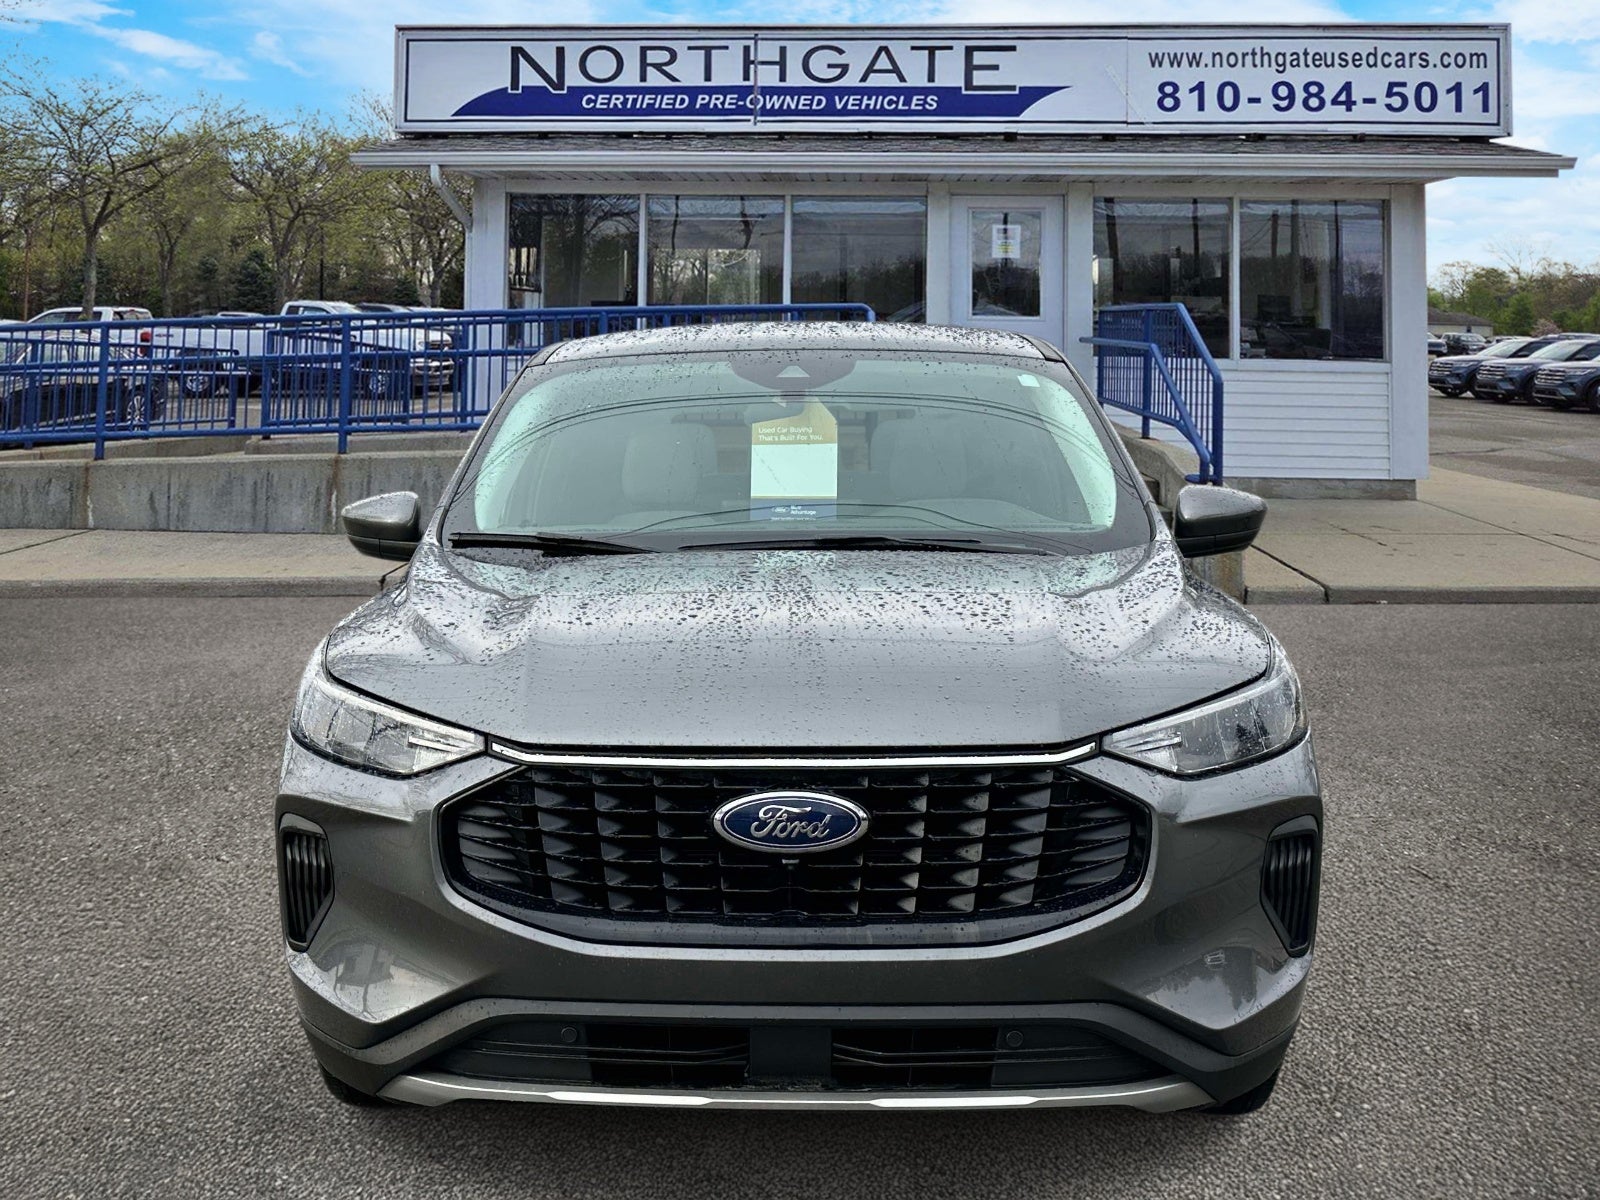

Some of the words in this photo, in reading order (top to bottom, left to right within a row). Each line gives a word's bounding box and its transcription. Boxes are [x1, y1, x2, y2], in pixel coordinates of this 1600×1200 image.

[510, 44, 1018, 92] NORTHGATE
[1147, 46, 1489, 74] www.northgateusedcars.com
[581, 94, 690, 110] CERTIFIED
[695, 95, 826, 111] PRE-OWNED
[834, 95, 939, 111] VEHICLES
[1156, 80, 1491, 114] 810-984-5011
[750, 804, 832, 838] Ford
